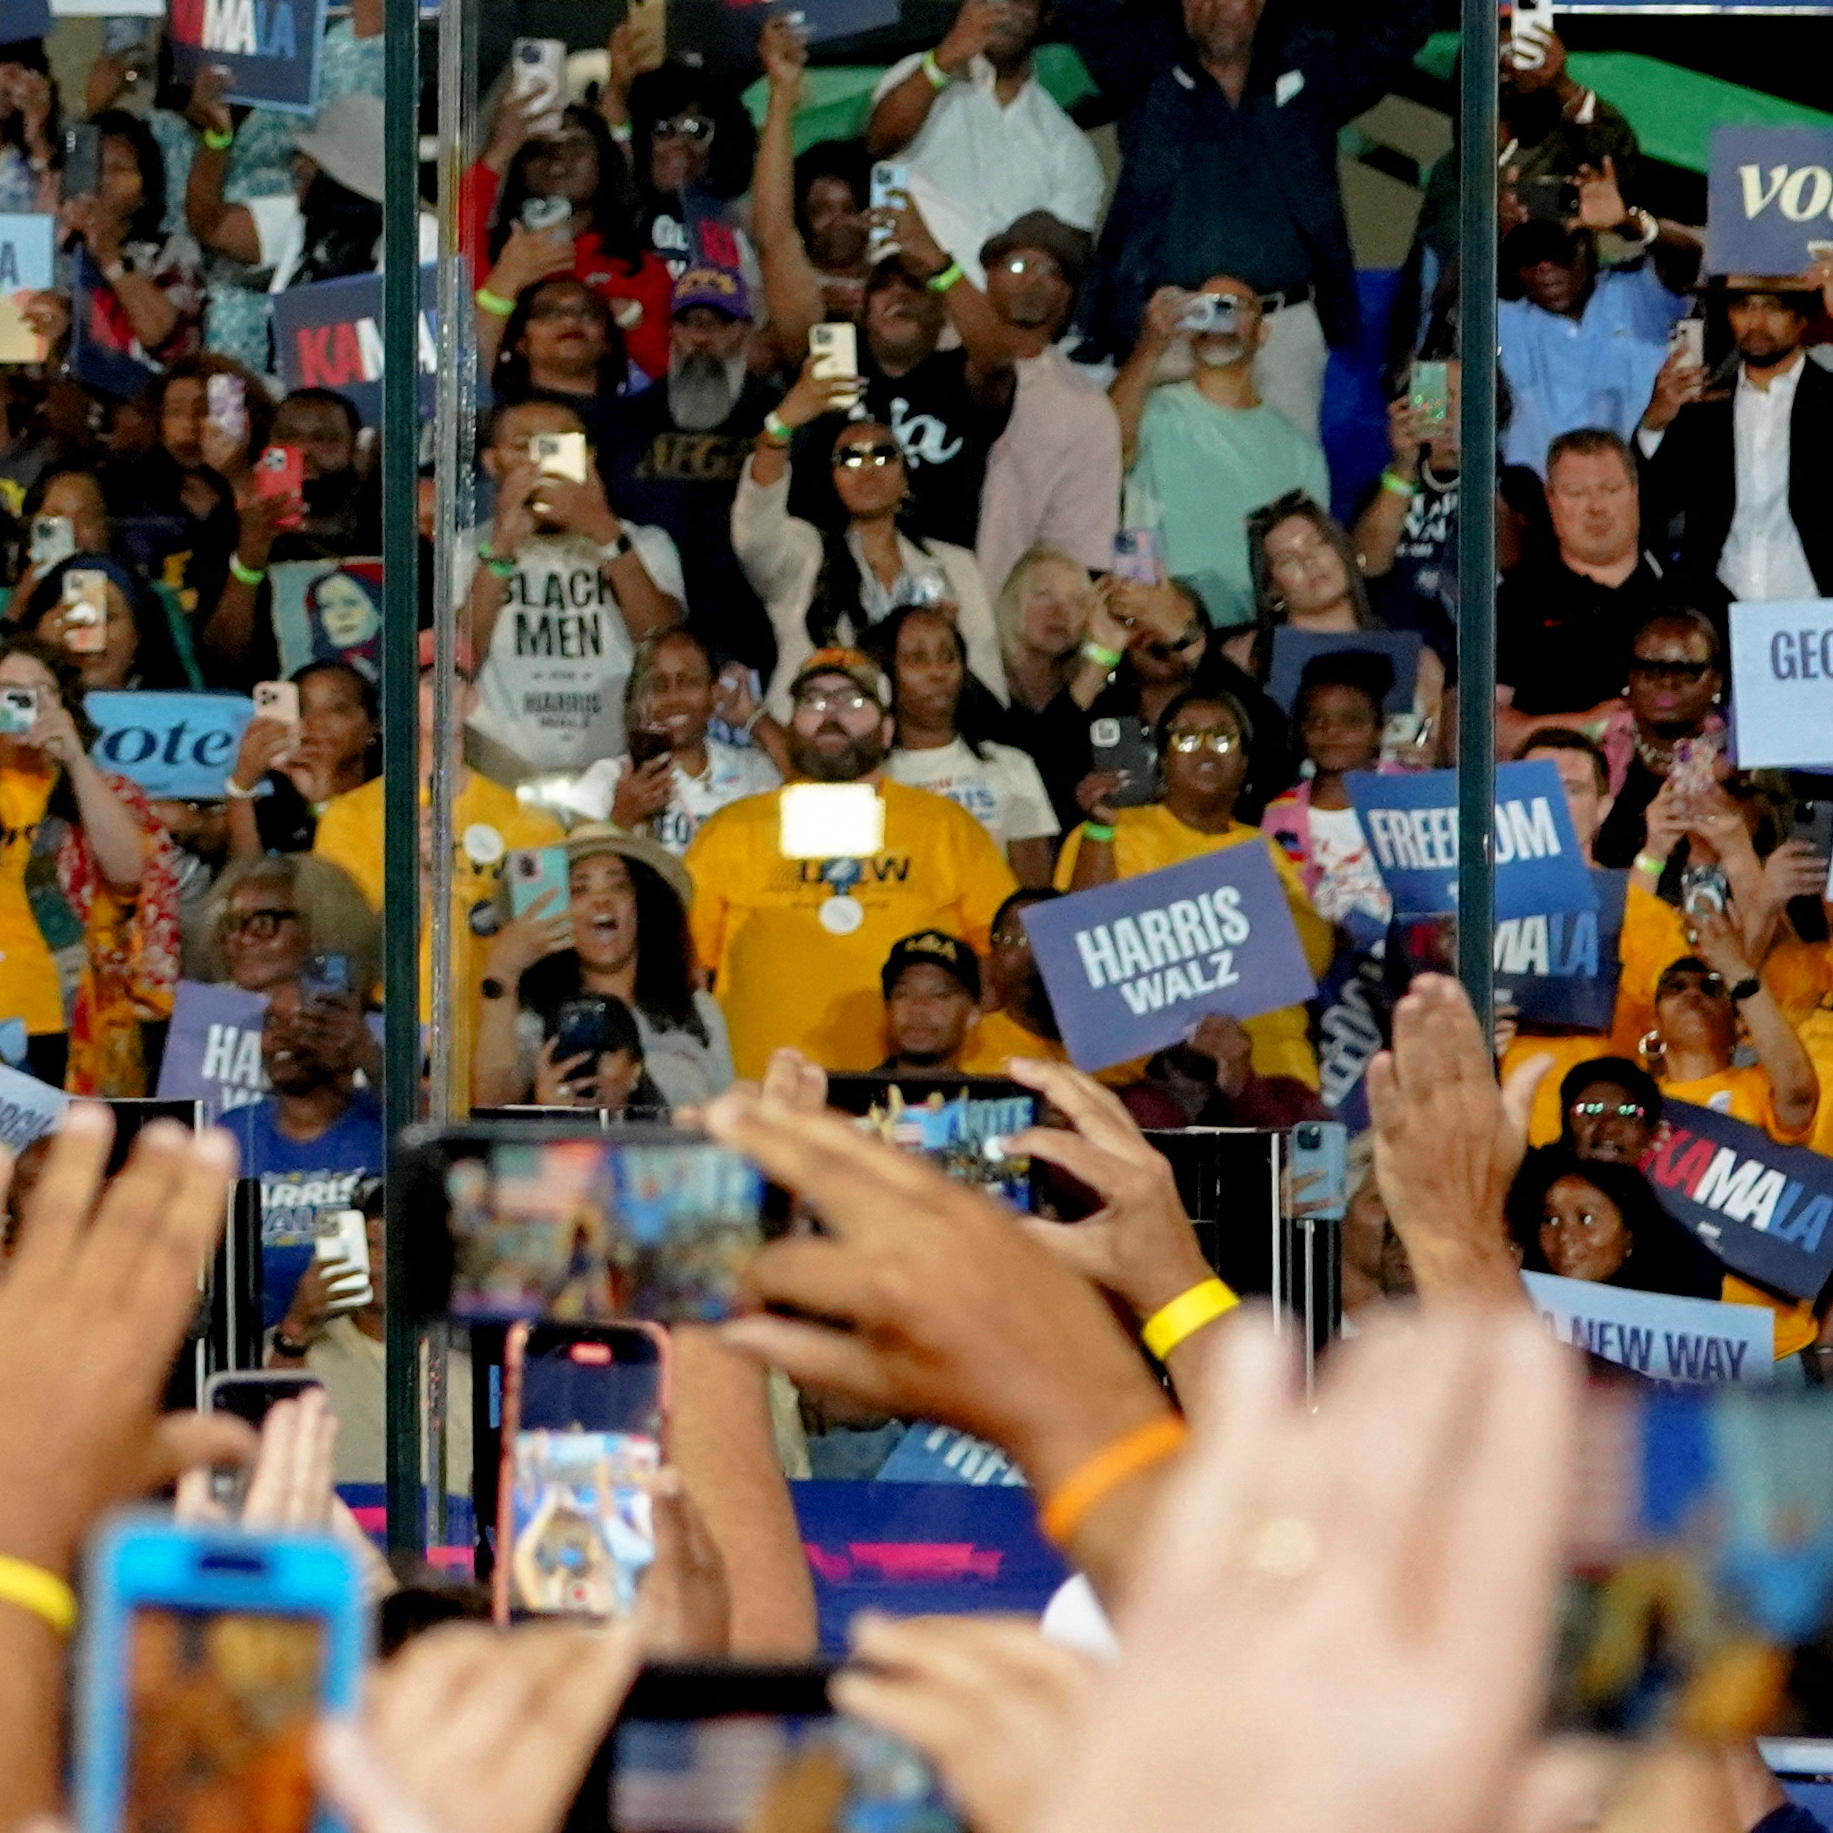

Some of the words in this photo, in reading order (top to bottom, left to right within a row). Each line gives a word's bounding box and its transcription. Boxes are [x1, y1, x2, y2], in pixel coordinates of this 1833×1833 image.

[515, 612, 604, 659] MEN
[97, 714, 233, 768] ote
[1074, 884, 1251, 990] HARRIS
[1119, 948, 1240, 1016] WALZ
[1636, 1119, 1833, 1254] KAMALA
[1570, 1316, 1654, 1373] NEW
[1665, 1330, 1750, 1384] WAY
